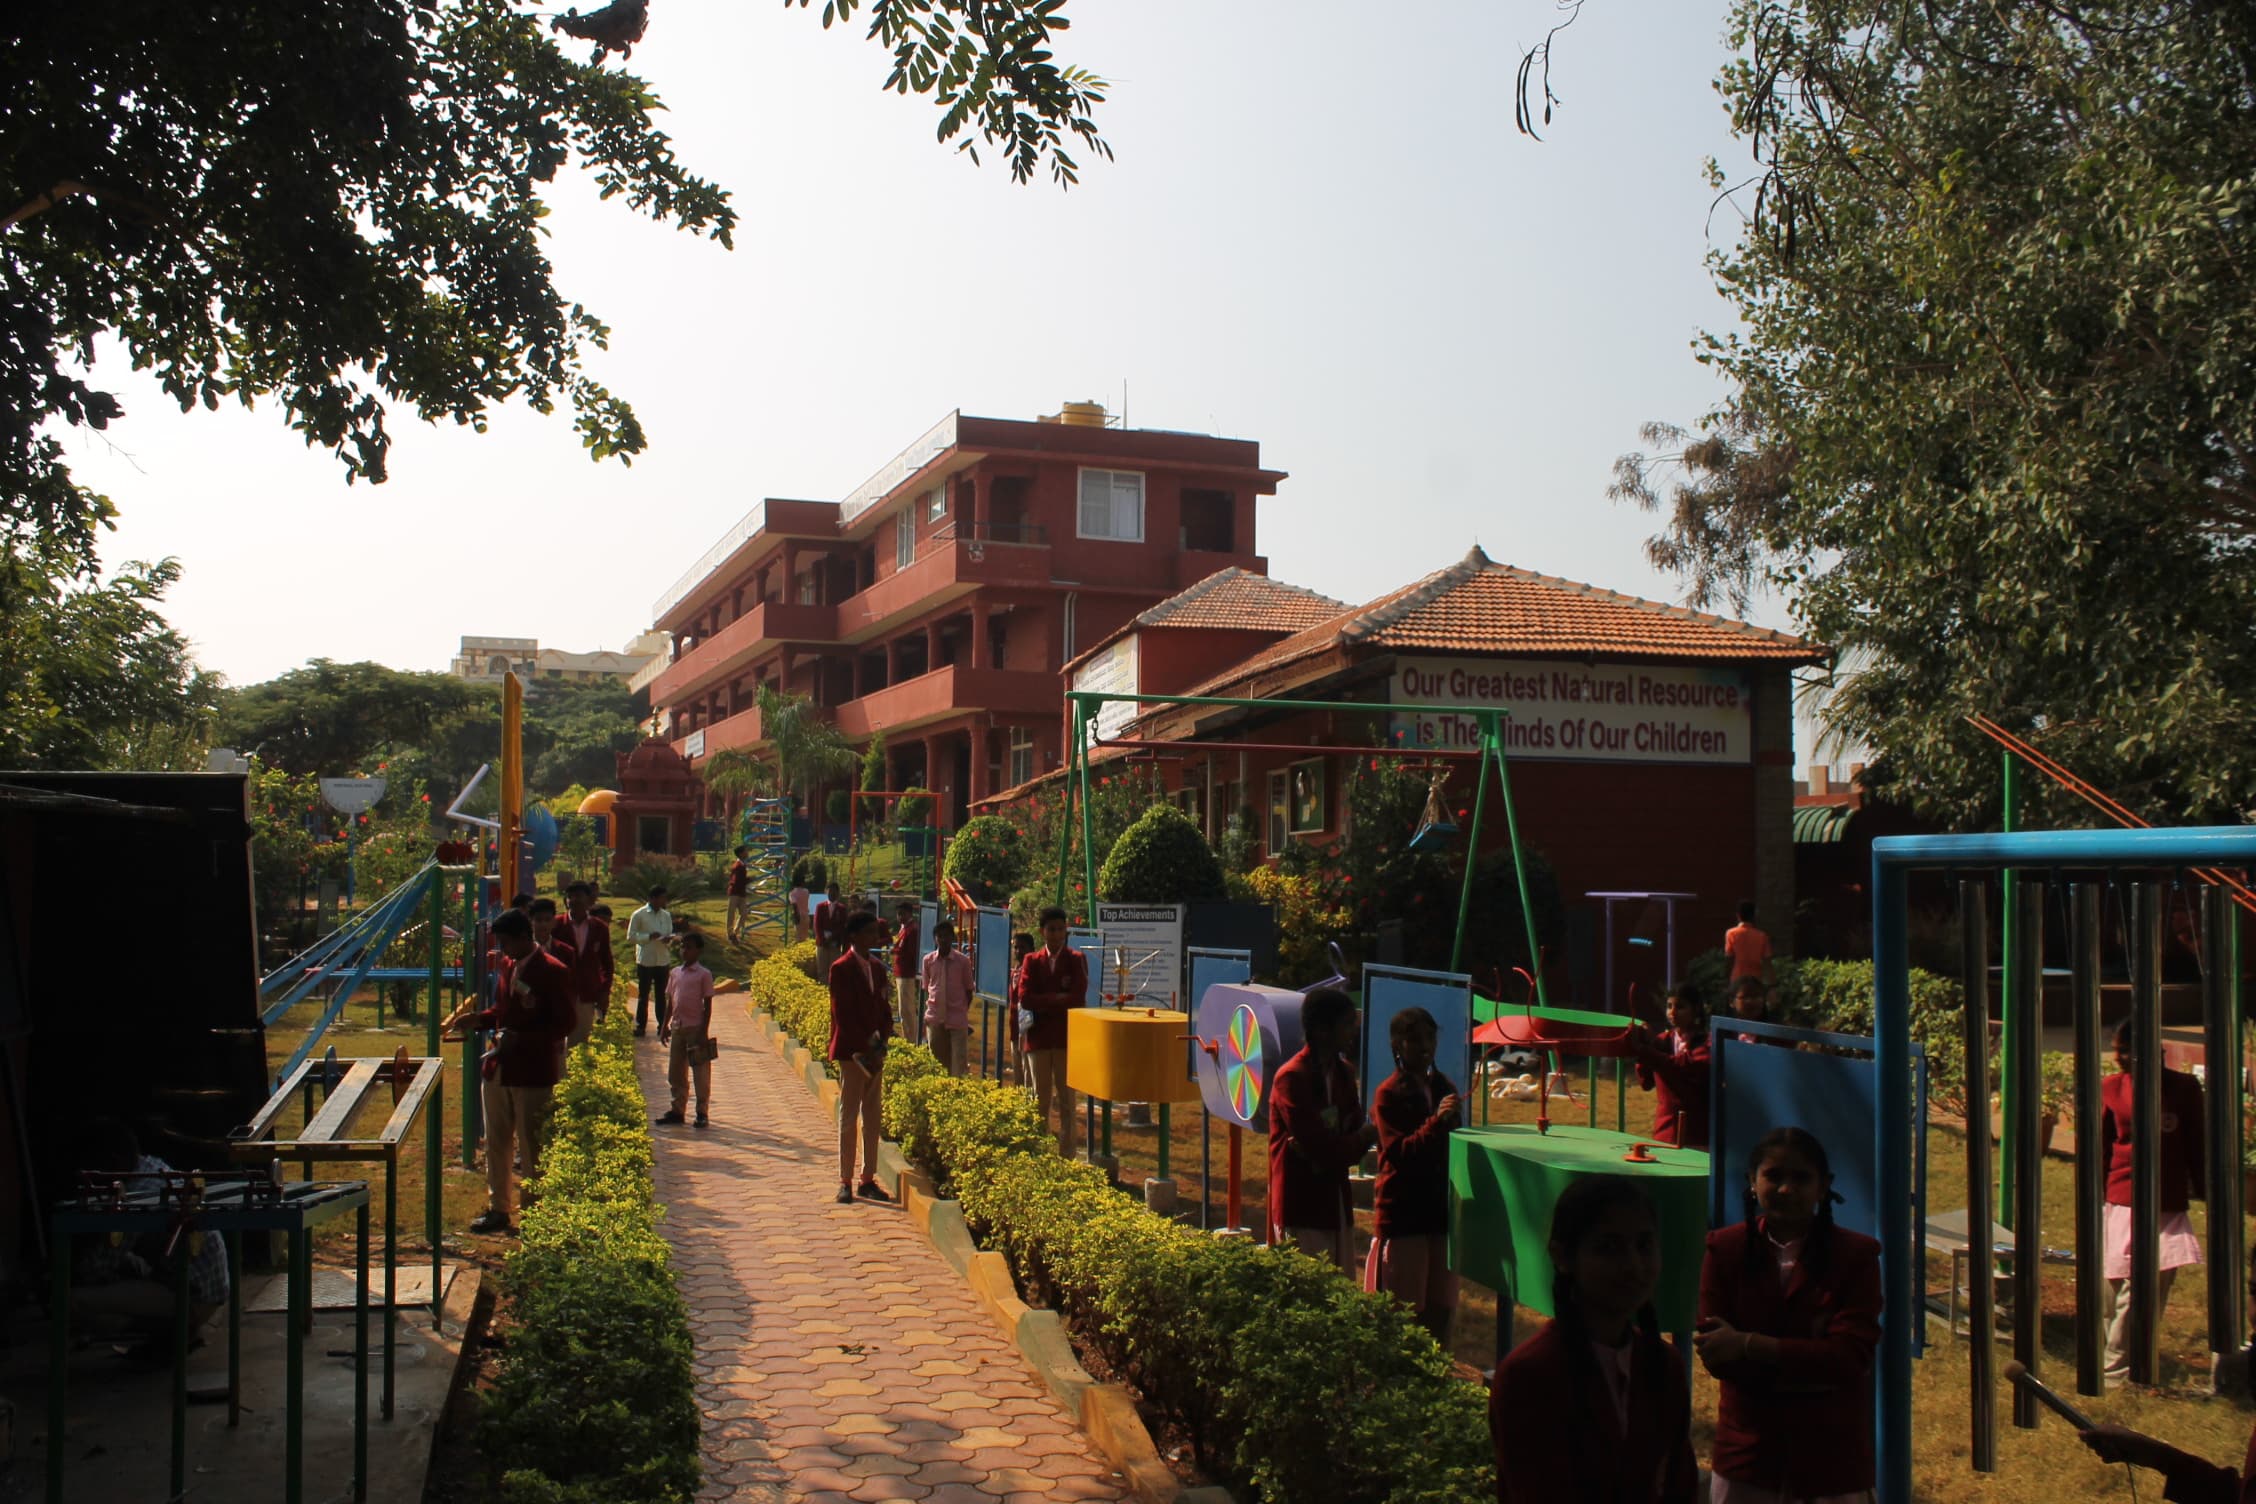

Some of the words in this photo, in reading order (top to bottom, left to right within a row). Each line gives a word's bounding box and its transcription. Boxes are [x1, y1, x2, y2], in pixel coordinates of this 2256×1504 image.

[1403, 667, 1444, 697] Our
[1450, 668, 1547, 700] Greatest
[1552, 671, 1634, 705] Natural
[1639, 676, 1738, 708] Resource
[1416, 714, 1434, 744] is
[1439, 714, 1478, 745] The
[1502, 717, 1555, 748] inds
[1560, 717, 1585, 748] Of
[1590, 720, 1630, 751] Our
[1634, 721, 1726, 753] Children
[1103, 909, 1117, 921] Top
[1119, 909, 1174, 920] Achievements
